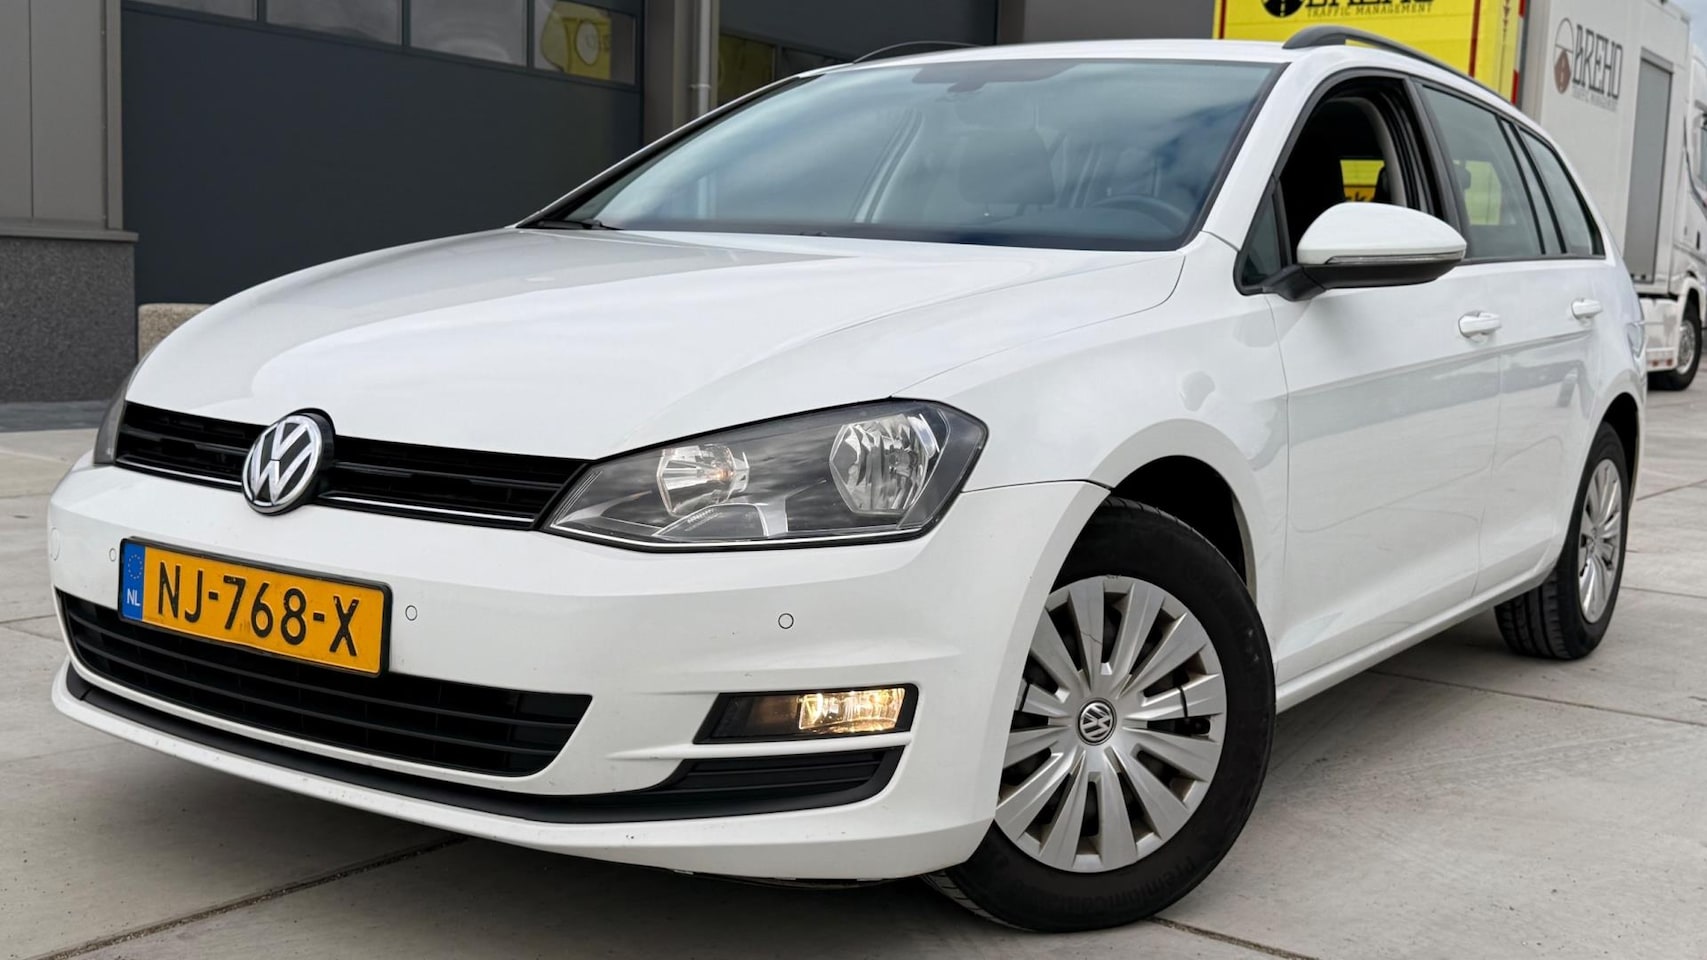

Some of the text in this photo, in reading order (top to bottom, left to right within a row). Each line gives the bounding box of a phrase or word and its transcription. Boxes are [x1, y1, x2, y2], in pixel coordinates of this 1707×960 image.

[1306, 6, 1350, 17] TRAFFIC
[1354, 3, 1433, 16] MANAGEMENT
[126, 588, 141, 607] NL
[157, 560, 360, 657] NJ-768-X
